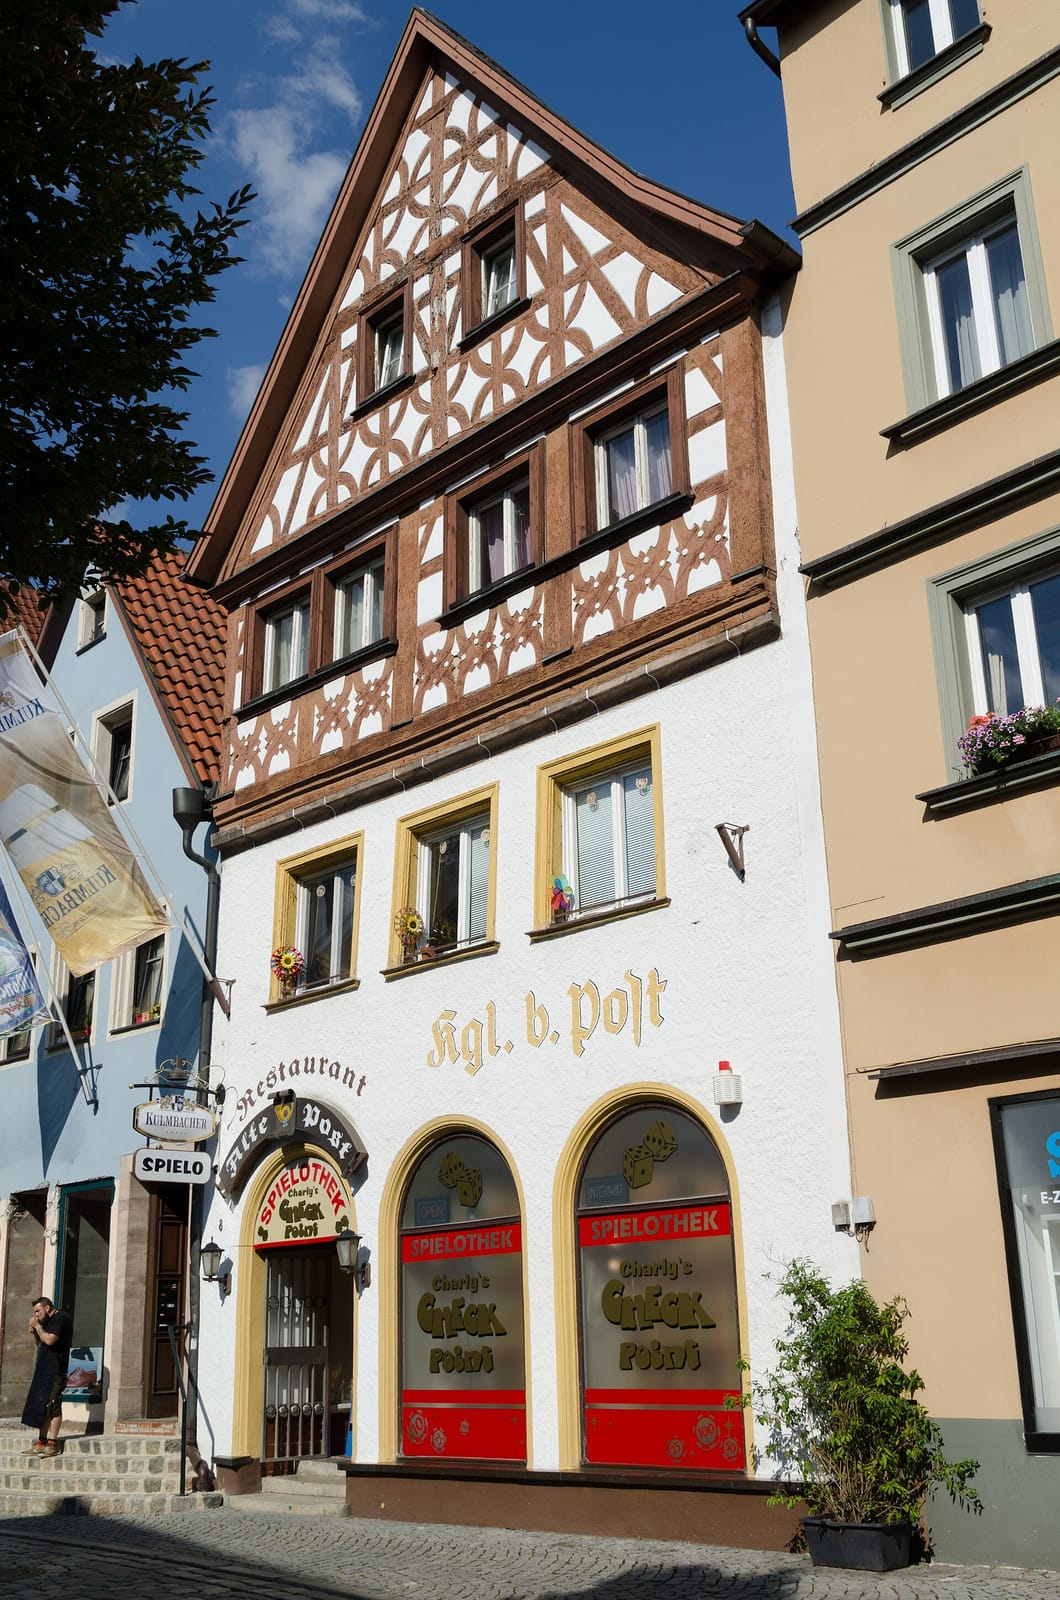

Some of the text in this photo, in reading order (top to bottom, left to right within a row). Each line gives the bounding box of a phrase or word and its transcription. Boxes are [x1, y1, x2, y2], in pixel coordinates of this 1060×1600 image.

[524, 990, 561, 1048] b.
[237, 1056, 367, 1121] Restaurant
[145, 1112, 207, 1130] KULMBACHER
[226, 1103, 353, 1178] Alte Post
[142, 1157, 204, 1175] SPIELO
[260, 1162, 346, 1226] SPIELOTHEK
[288, 1186, 319, 1198] Charly's
[590, 1209, 719, 1240] SPIELOTHEK
[411, 1230, 513, 1257] SPIELOTHEK
[619, 1257, 693, 1280] Charly's
[431, 1273, 490, 1293] Charly's
